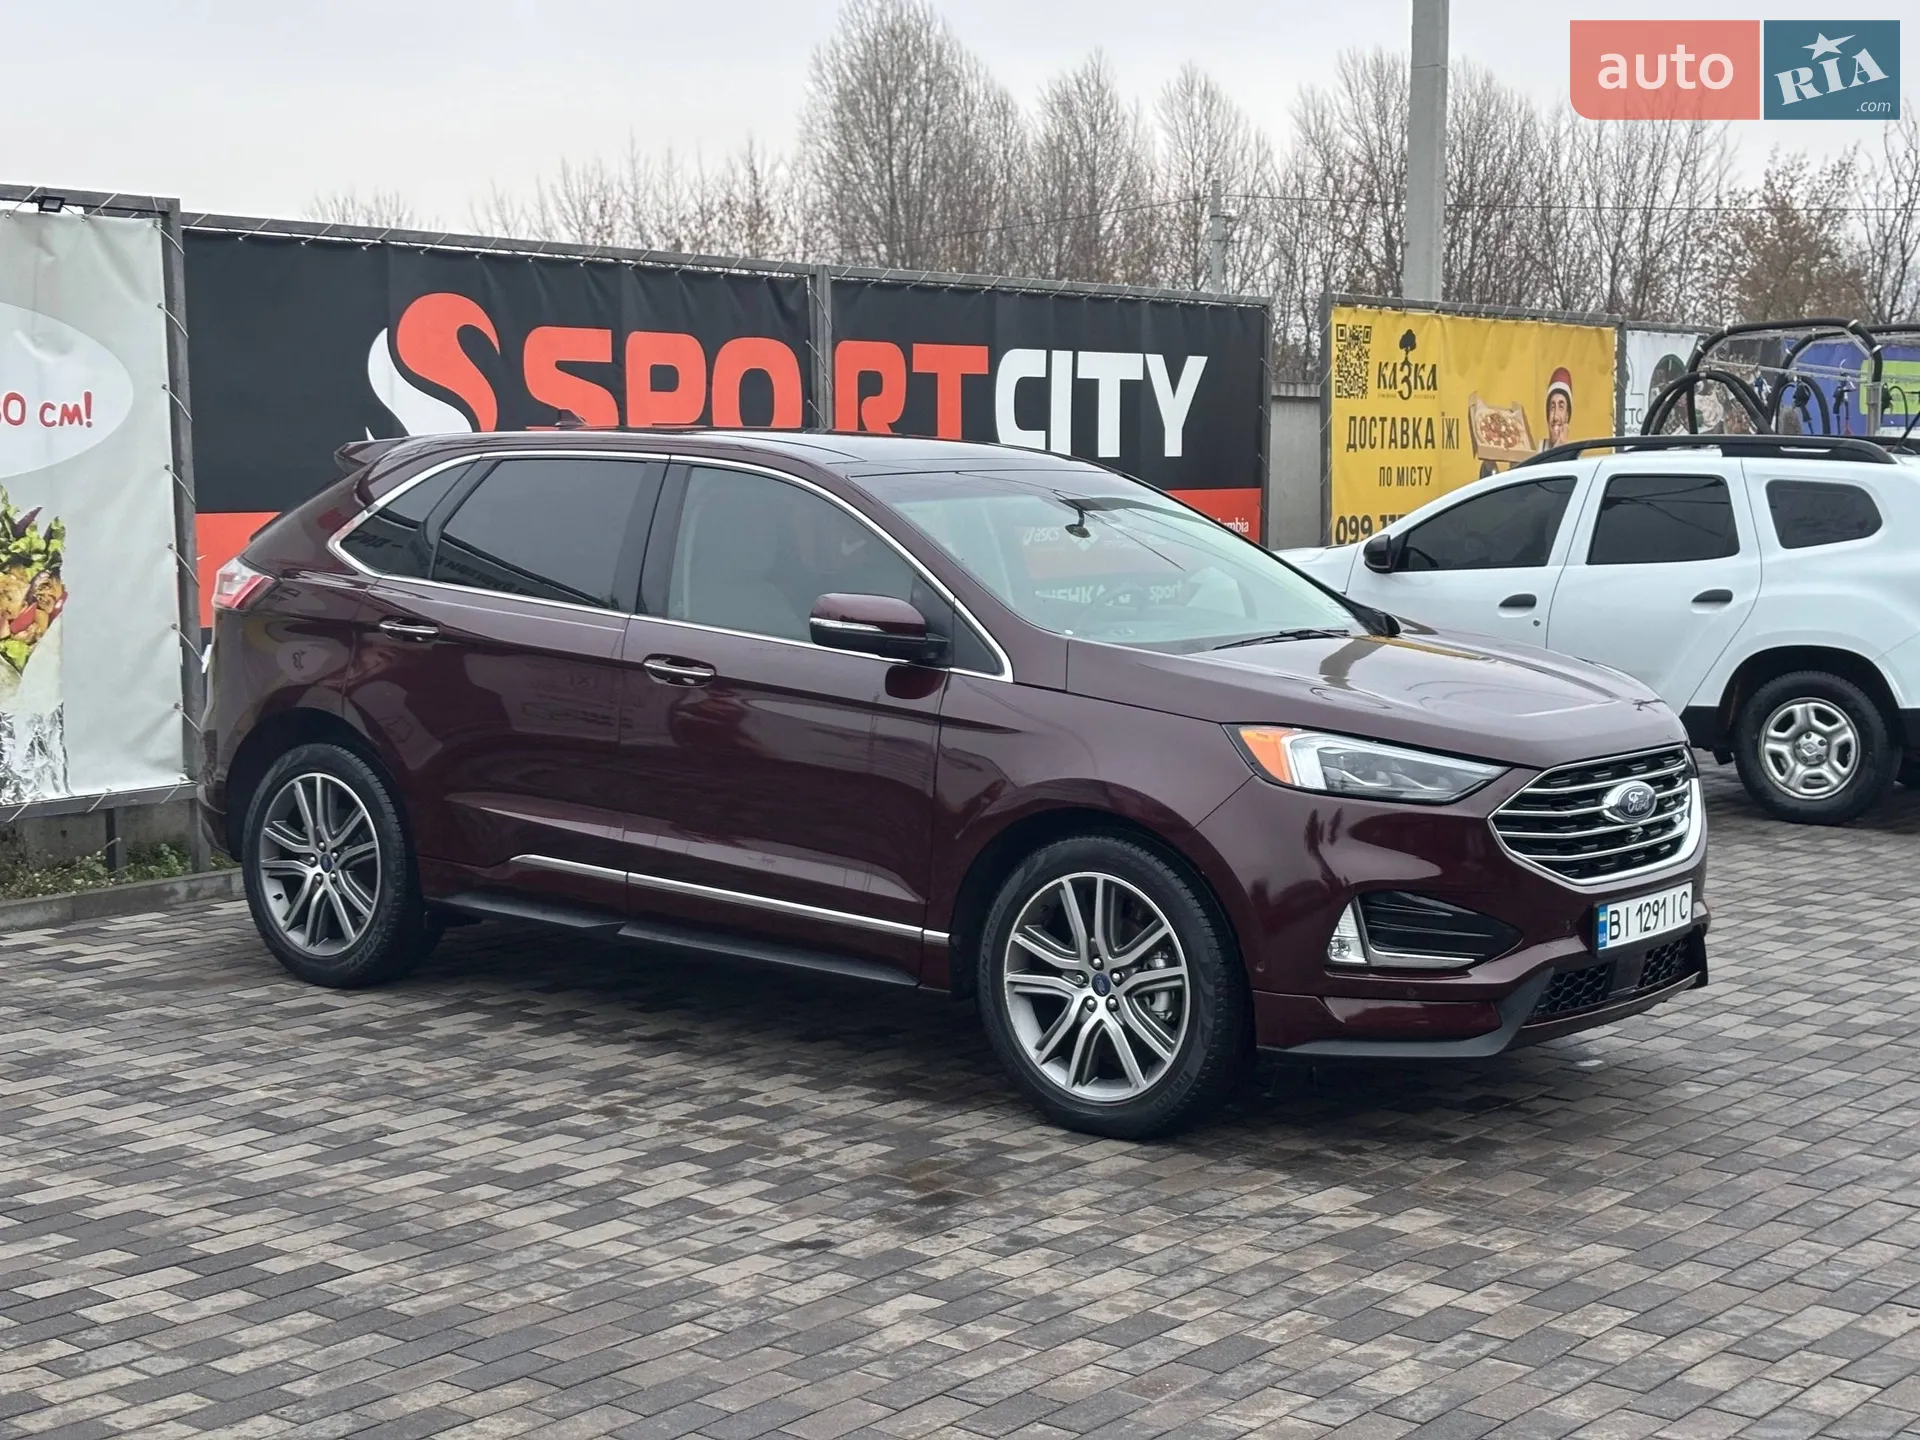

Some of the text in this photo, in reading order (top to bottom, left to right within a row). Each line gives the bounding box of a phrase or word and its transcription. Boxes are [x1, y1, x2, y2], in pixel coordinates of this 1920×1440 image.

[0, 391, 26, 426] 0
[1346, 411, 1460, 453] ДОСТАВКА ЇЖІ
[1379, 466, 1432, 487] ПО МІСТУ
[1335, 514, 1373, 545] 099
[1636, 897, 1667, 933] 1291
